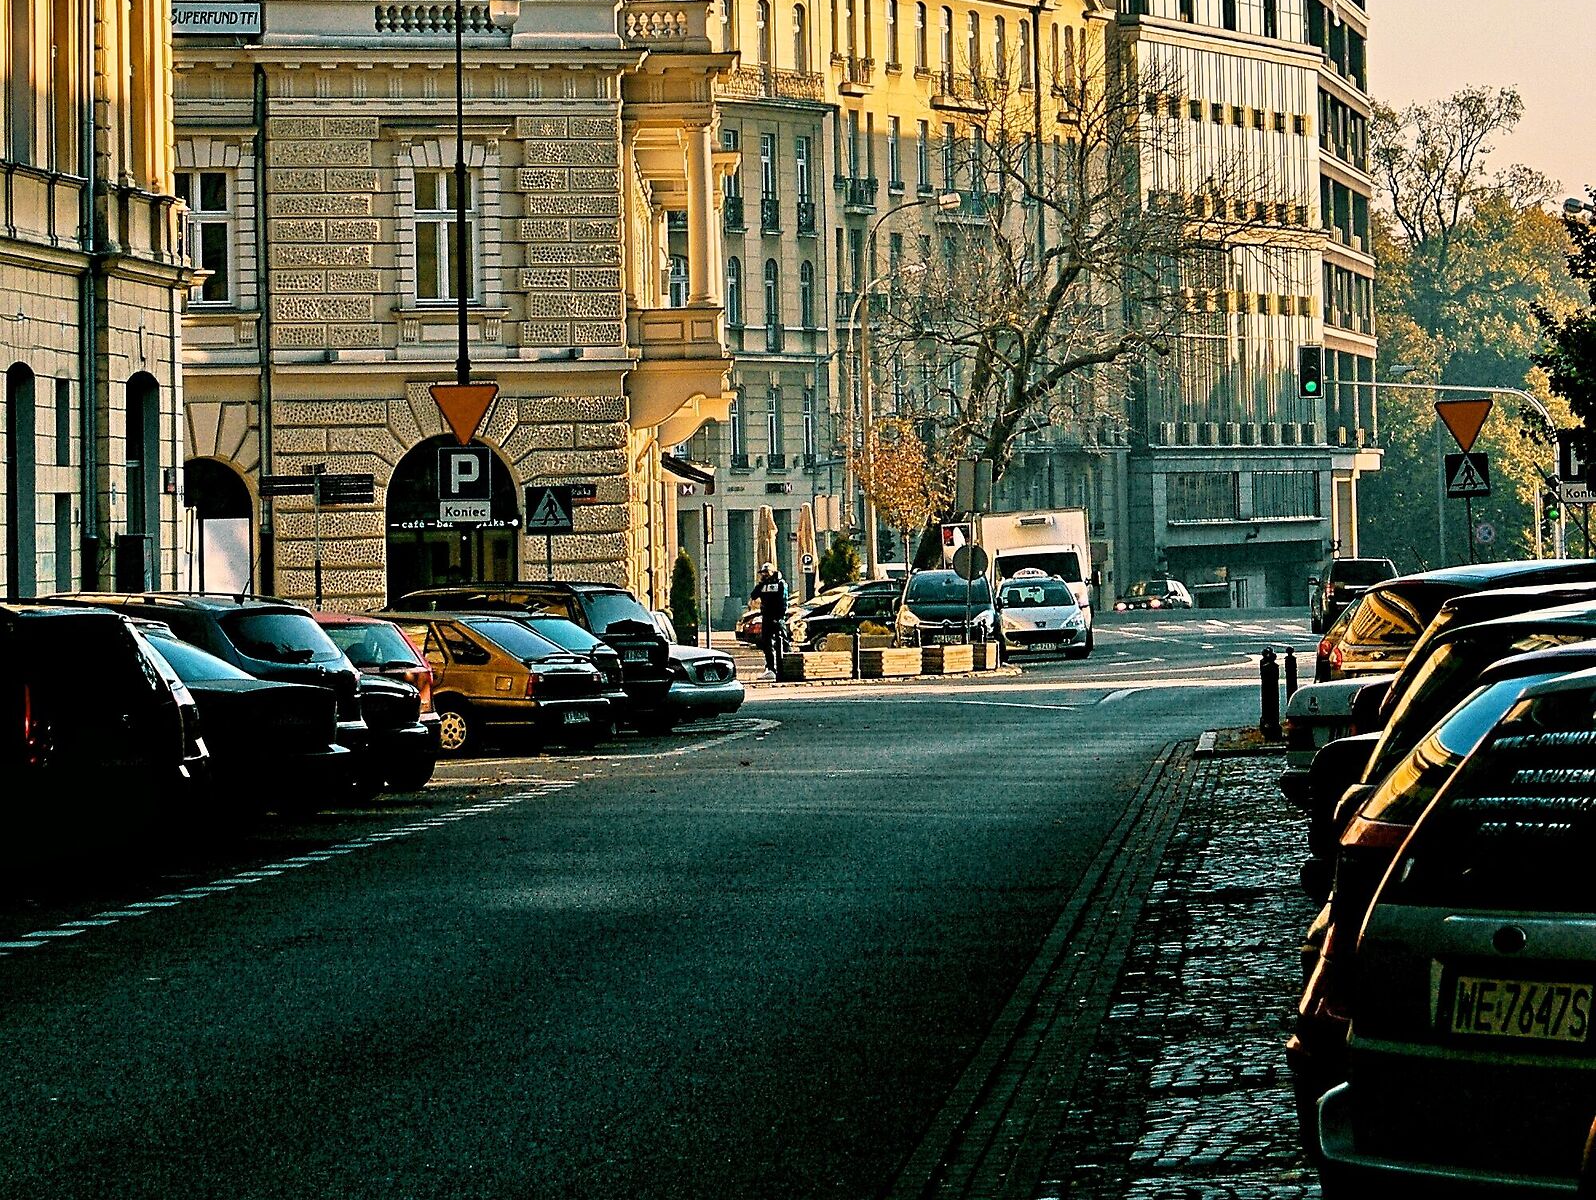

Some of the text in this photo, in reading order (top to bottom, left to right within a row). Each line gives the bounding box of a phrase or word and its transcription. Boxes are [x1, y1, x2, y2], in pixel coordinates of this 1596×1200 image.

[171, 8, 258, 26] SUPERFUND TFI
[451, 454, 480, 493] P
[445, 506, 486, 517] Koniec
[1511, 768, 1596, 784] PRACUJEM
